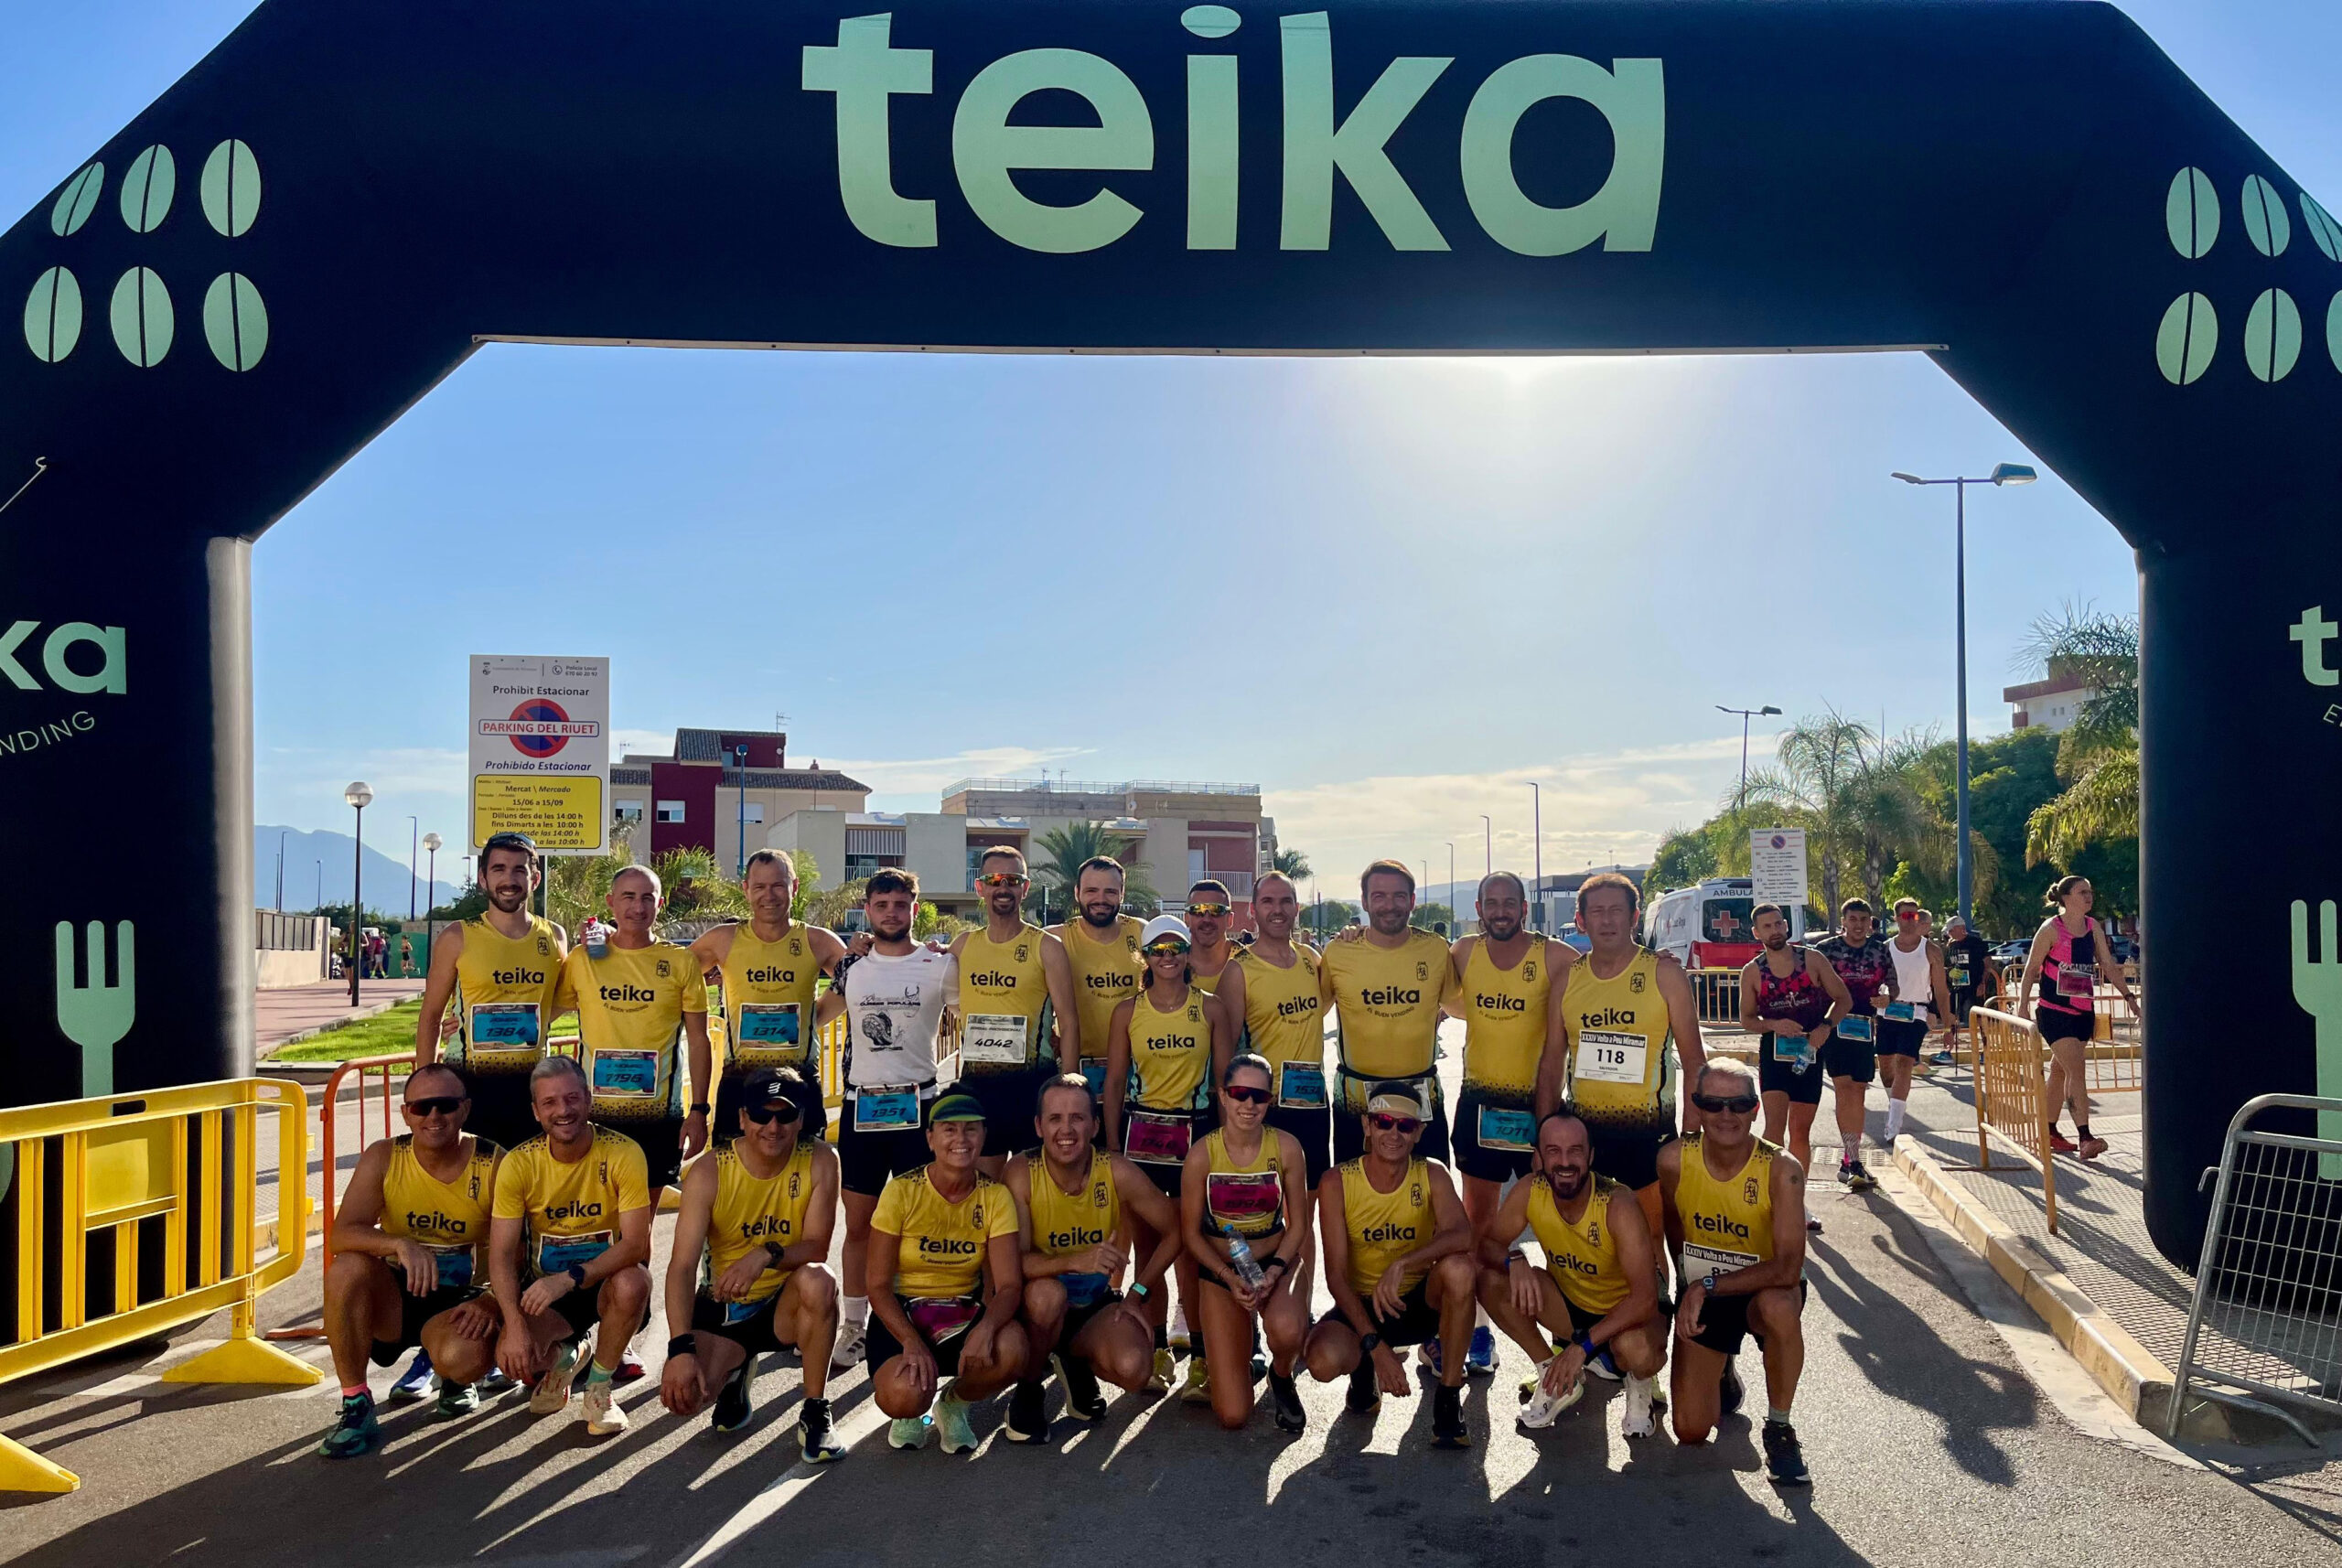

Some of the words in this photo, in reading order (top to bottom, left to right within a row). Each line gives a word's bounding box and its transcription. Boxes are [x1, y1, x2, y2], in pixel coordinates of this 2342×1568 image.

[801, 5, 1665, 257] teika
[493, 685, 533, 695] Prohibit
[537, 686, 589, 696] Estacionar
[483, 723, 534, 732] PARKING
[538, 724, 558, 734] DEL
[562, 725, 595, 735] RIUET
[485, 761, 534, 770] Prohibido
[538, 761, 591, 771] Estacionar
[512, 799, 534, 807] 15/06
[492, 967, 544, 984] teika
[747, 966, 794, 983] teika
[970, 971, 1016, 988] teika
[1086, 972, 1133, 988] teika
[600, 984, 654, 1002] teika
[1361, 986, 1420, 1004] teika
[1277, 995, 1317, 1016] teika
[1477, 993, 1525, 1012] teika
[1581, 1008, 1635, 1028] teika
[974, 1037, 1014, 1048] 4042
[1147, 1034, 1195, 1050] teika
[1597, 1034, 1609, 1043] Volta
[1623, 1036, 1645, 1047] Miramar
[1597, 1048, 1625, 1064] 118
[544, 1200, 602, 1220] teika
[406, 1211, 467, 1233] teika
[741, 1215, 790, 1239] teika
[1692, 1212, 1749, 1239] teika
[1048, 1228, 1103, 1248] teika
[1363, 1223, 1416, 1242] teika
[919, 1236, 976, 1253] teika
[1548, 1250, 1598, 1275] teika
[1703, 1250, 1717, 1261] Volta
[1722, 1253, 1734, 1264] Peu
